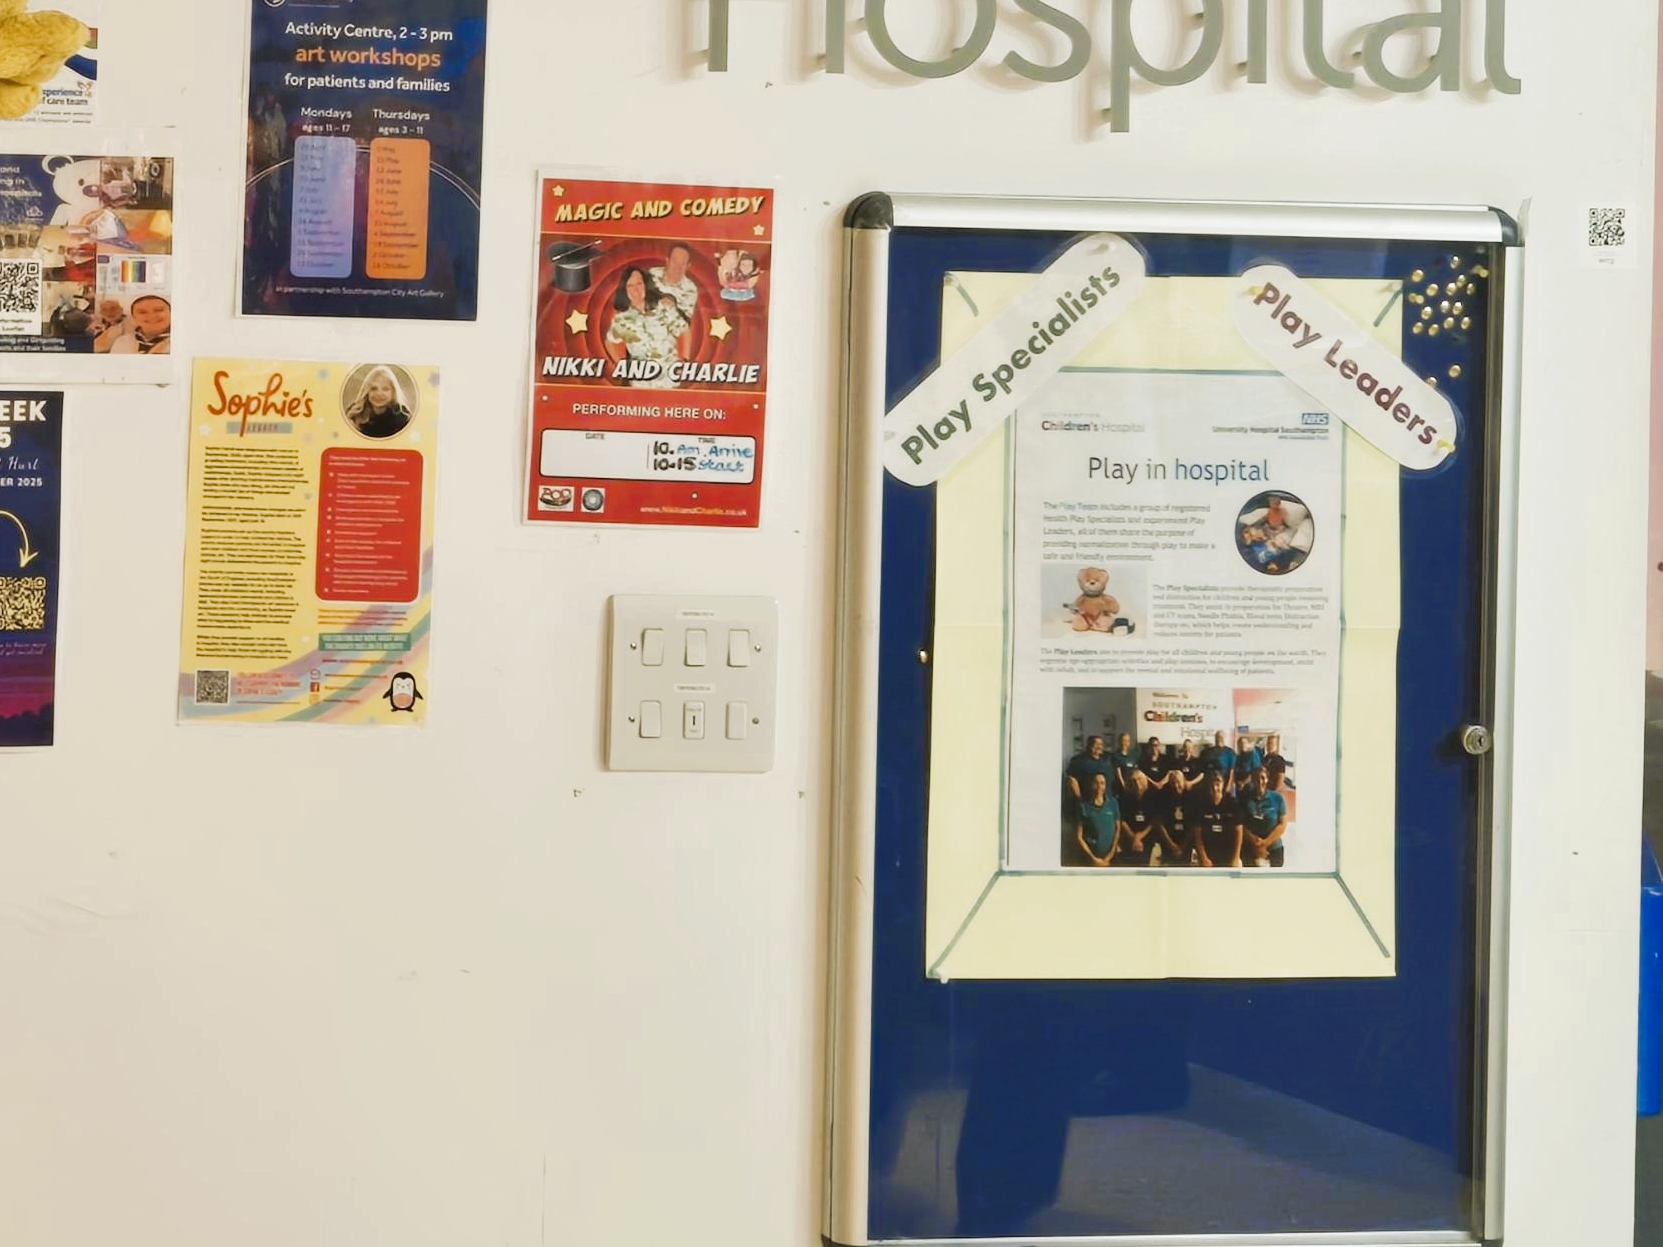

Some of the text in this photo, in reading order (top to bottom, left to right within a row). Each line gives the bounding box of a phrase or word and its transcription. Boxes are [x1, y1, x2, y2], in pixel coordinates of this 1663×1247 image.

[285, 21, 342, 40] Activity
[343, 23, 396, 41] Centre,
[399, 27, 407, 39] 2
[419, 27, 428, 40] 3
[430, 29, 453, 44] pm
[295, 46, 441, 71] art workshops
[284, 72, 450, 92] for patients and families
[300, 106, 353, 120] Mondays
[372, 108, 431, 122] Thursdays
[554, 196, 764, 222] MAGIC AND COMEDY
[542, 356, 760, 384] NIKKI AND CHARLIE
[900, 266, 1121, 465] Play Specialists
[1252, 281, 1437, 445] Play Leaders
[572, 403, 727, 420] PERFORMING HERE ON:
[1303, 414, 1328, 425] NHS
[17, 477, 43, 487] 2025
[1088, 457, 1269, 486] Play in hospital
